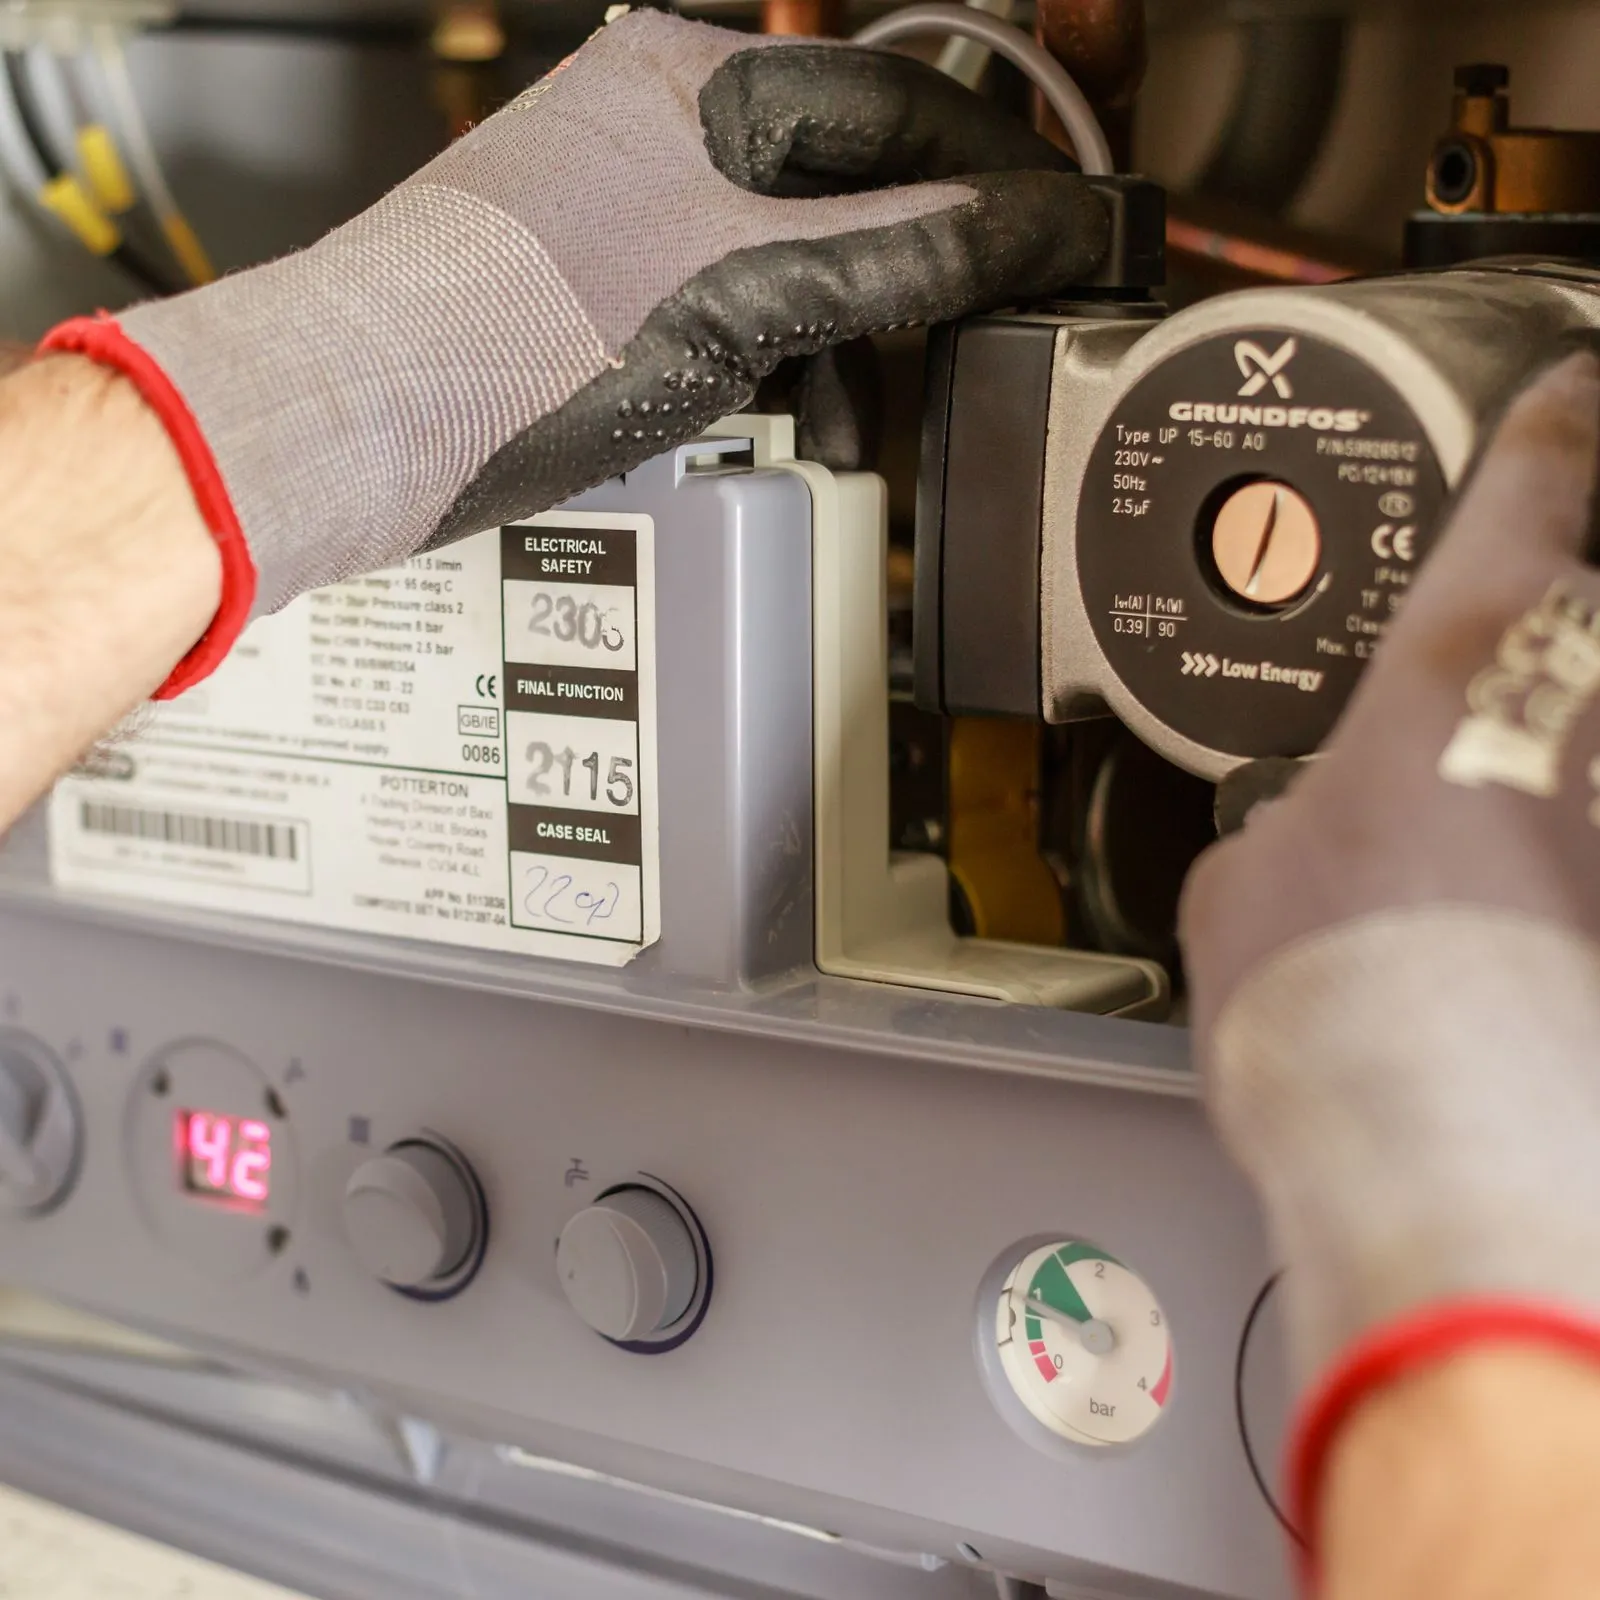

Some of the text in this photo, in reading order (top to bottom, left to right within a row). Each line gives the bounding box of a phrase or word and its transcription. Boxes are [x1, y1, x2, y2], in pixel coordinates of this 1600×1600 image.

[1168, 402, 1363, 432] GRUNDFOS
[1116, 424, 1150, 445] Type
[1159, 427, 1178, 444] UP
[1187, 429, 1233, 448] 15-60
[1113, 474, 1147, 491] 50Hz
[525, 537, 607, 555] ELECTRICAL
[541, 558, 593, 574] SAFETY
[1114, 618, 1175, 637] 0.39 90
[1222, 658, 1323, 692] Low Energy
[476, 674, 496, 698] CE
[517, 680, 624, 701] FINAL FUNCTION
[460, 714, 497, 730] GB/IE
[462, 744, 500, 764] 0086
[380, 775, 469, 798] POTTERTON
[537, 822, 611, 844] CASE SEAL
[189, 1113, 271, 1200] 42
[1094, 1262, 1105, 1279] 2
[1150, 1309, 1161, 1327] 3
[1053, 1354, 1064, 1369] 0
[1137, 1376, 1147, 1391] 4
[1089, 1398, 1116, 1417] bar
